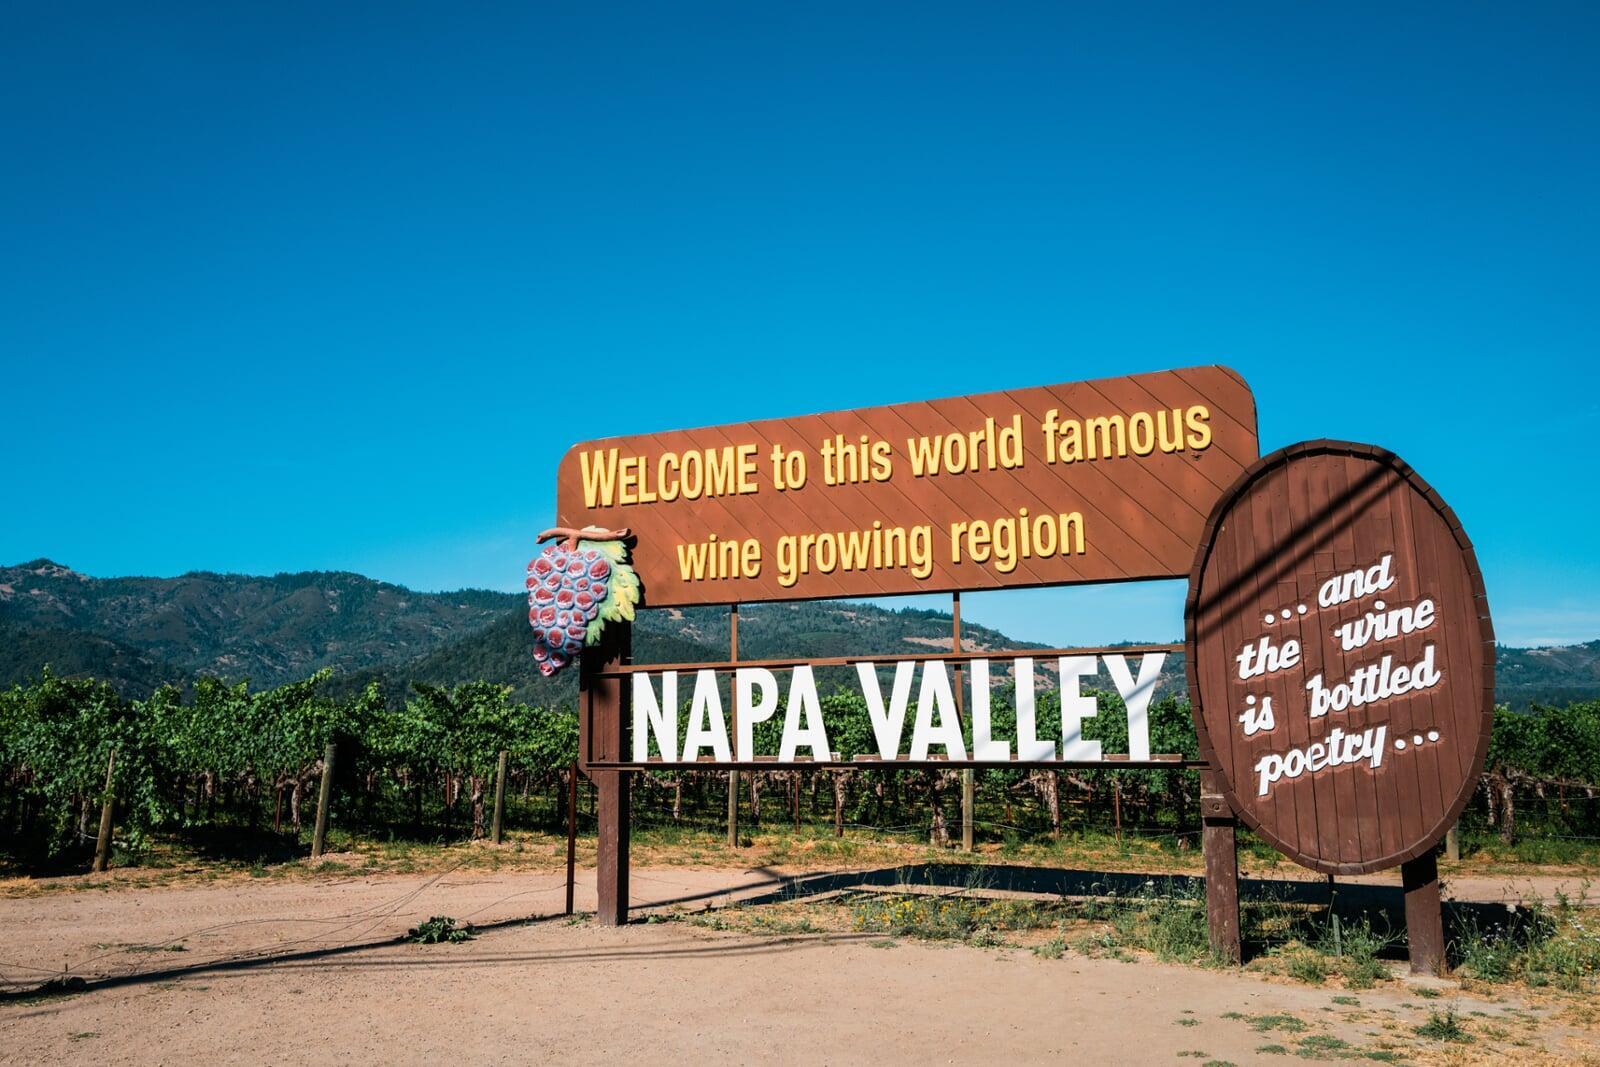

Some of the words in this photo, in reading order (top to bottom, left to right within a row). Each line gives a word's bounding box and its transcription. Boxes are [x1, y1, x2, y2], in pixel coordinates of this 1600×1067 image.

[579, 442, 759, 508] WELCOME
[769, 443, 806, 490] to
[820, 433, 892, 485] this
[906, 413, 1024, 476] world
[1041, 404, 1212, 463] famous
[676, 533, 761, 581] wine
[776, 520, 933, 587] growing
[950, 506, 1085, 572] region
[1235, 636, 1300, 680] the
[1334, 598, 1436, 651] wine
[632, 665, 830, 763] NAPA
[855, 654, 1167, 762] VALLEY
[1238, 695, 1275, 736] is
[1305, 645, 1441, 718] bottled
